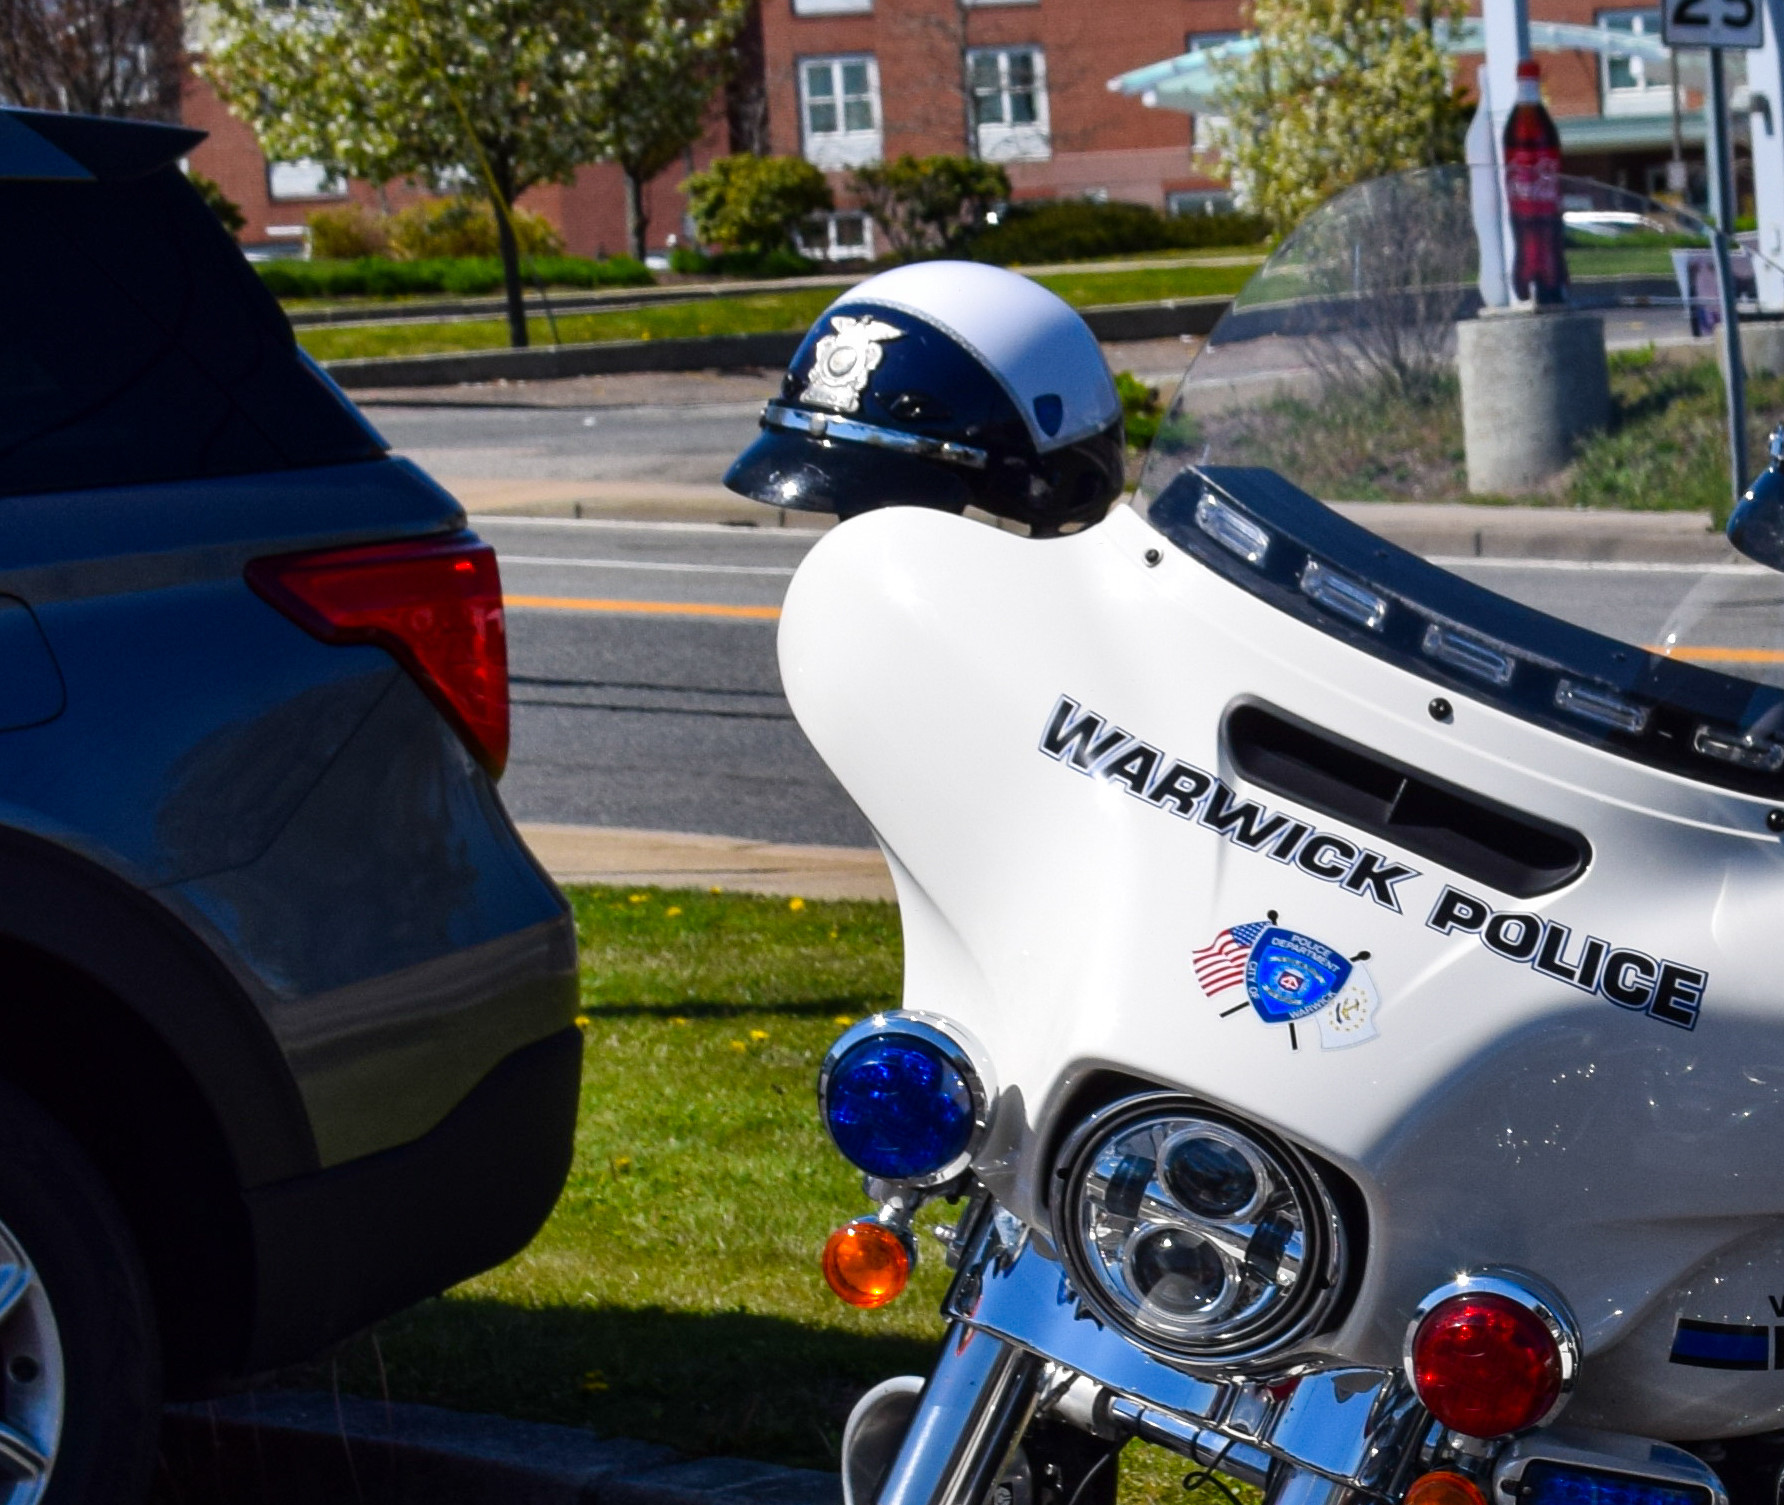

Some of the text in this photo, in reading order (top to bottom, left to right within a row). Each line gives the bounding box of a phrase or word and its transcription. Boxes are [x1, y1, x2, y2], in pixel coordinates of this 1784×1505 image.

[1039, 694, 1708, 1030] WARWICK POLICE
[1271, 937, 1341, 973] DEPARTMENT
[1291, 934, 1333, 958] POLICE
[1247, 961, 1261, 1000] CITY OF
[1289, 992, 1337, 1019] WARWICK
